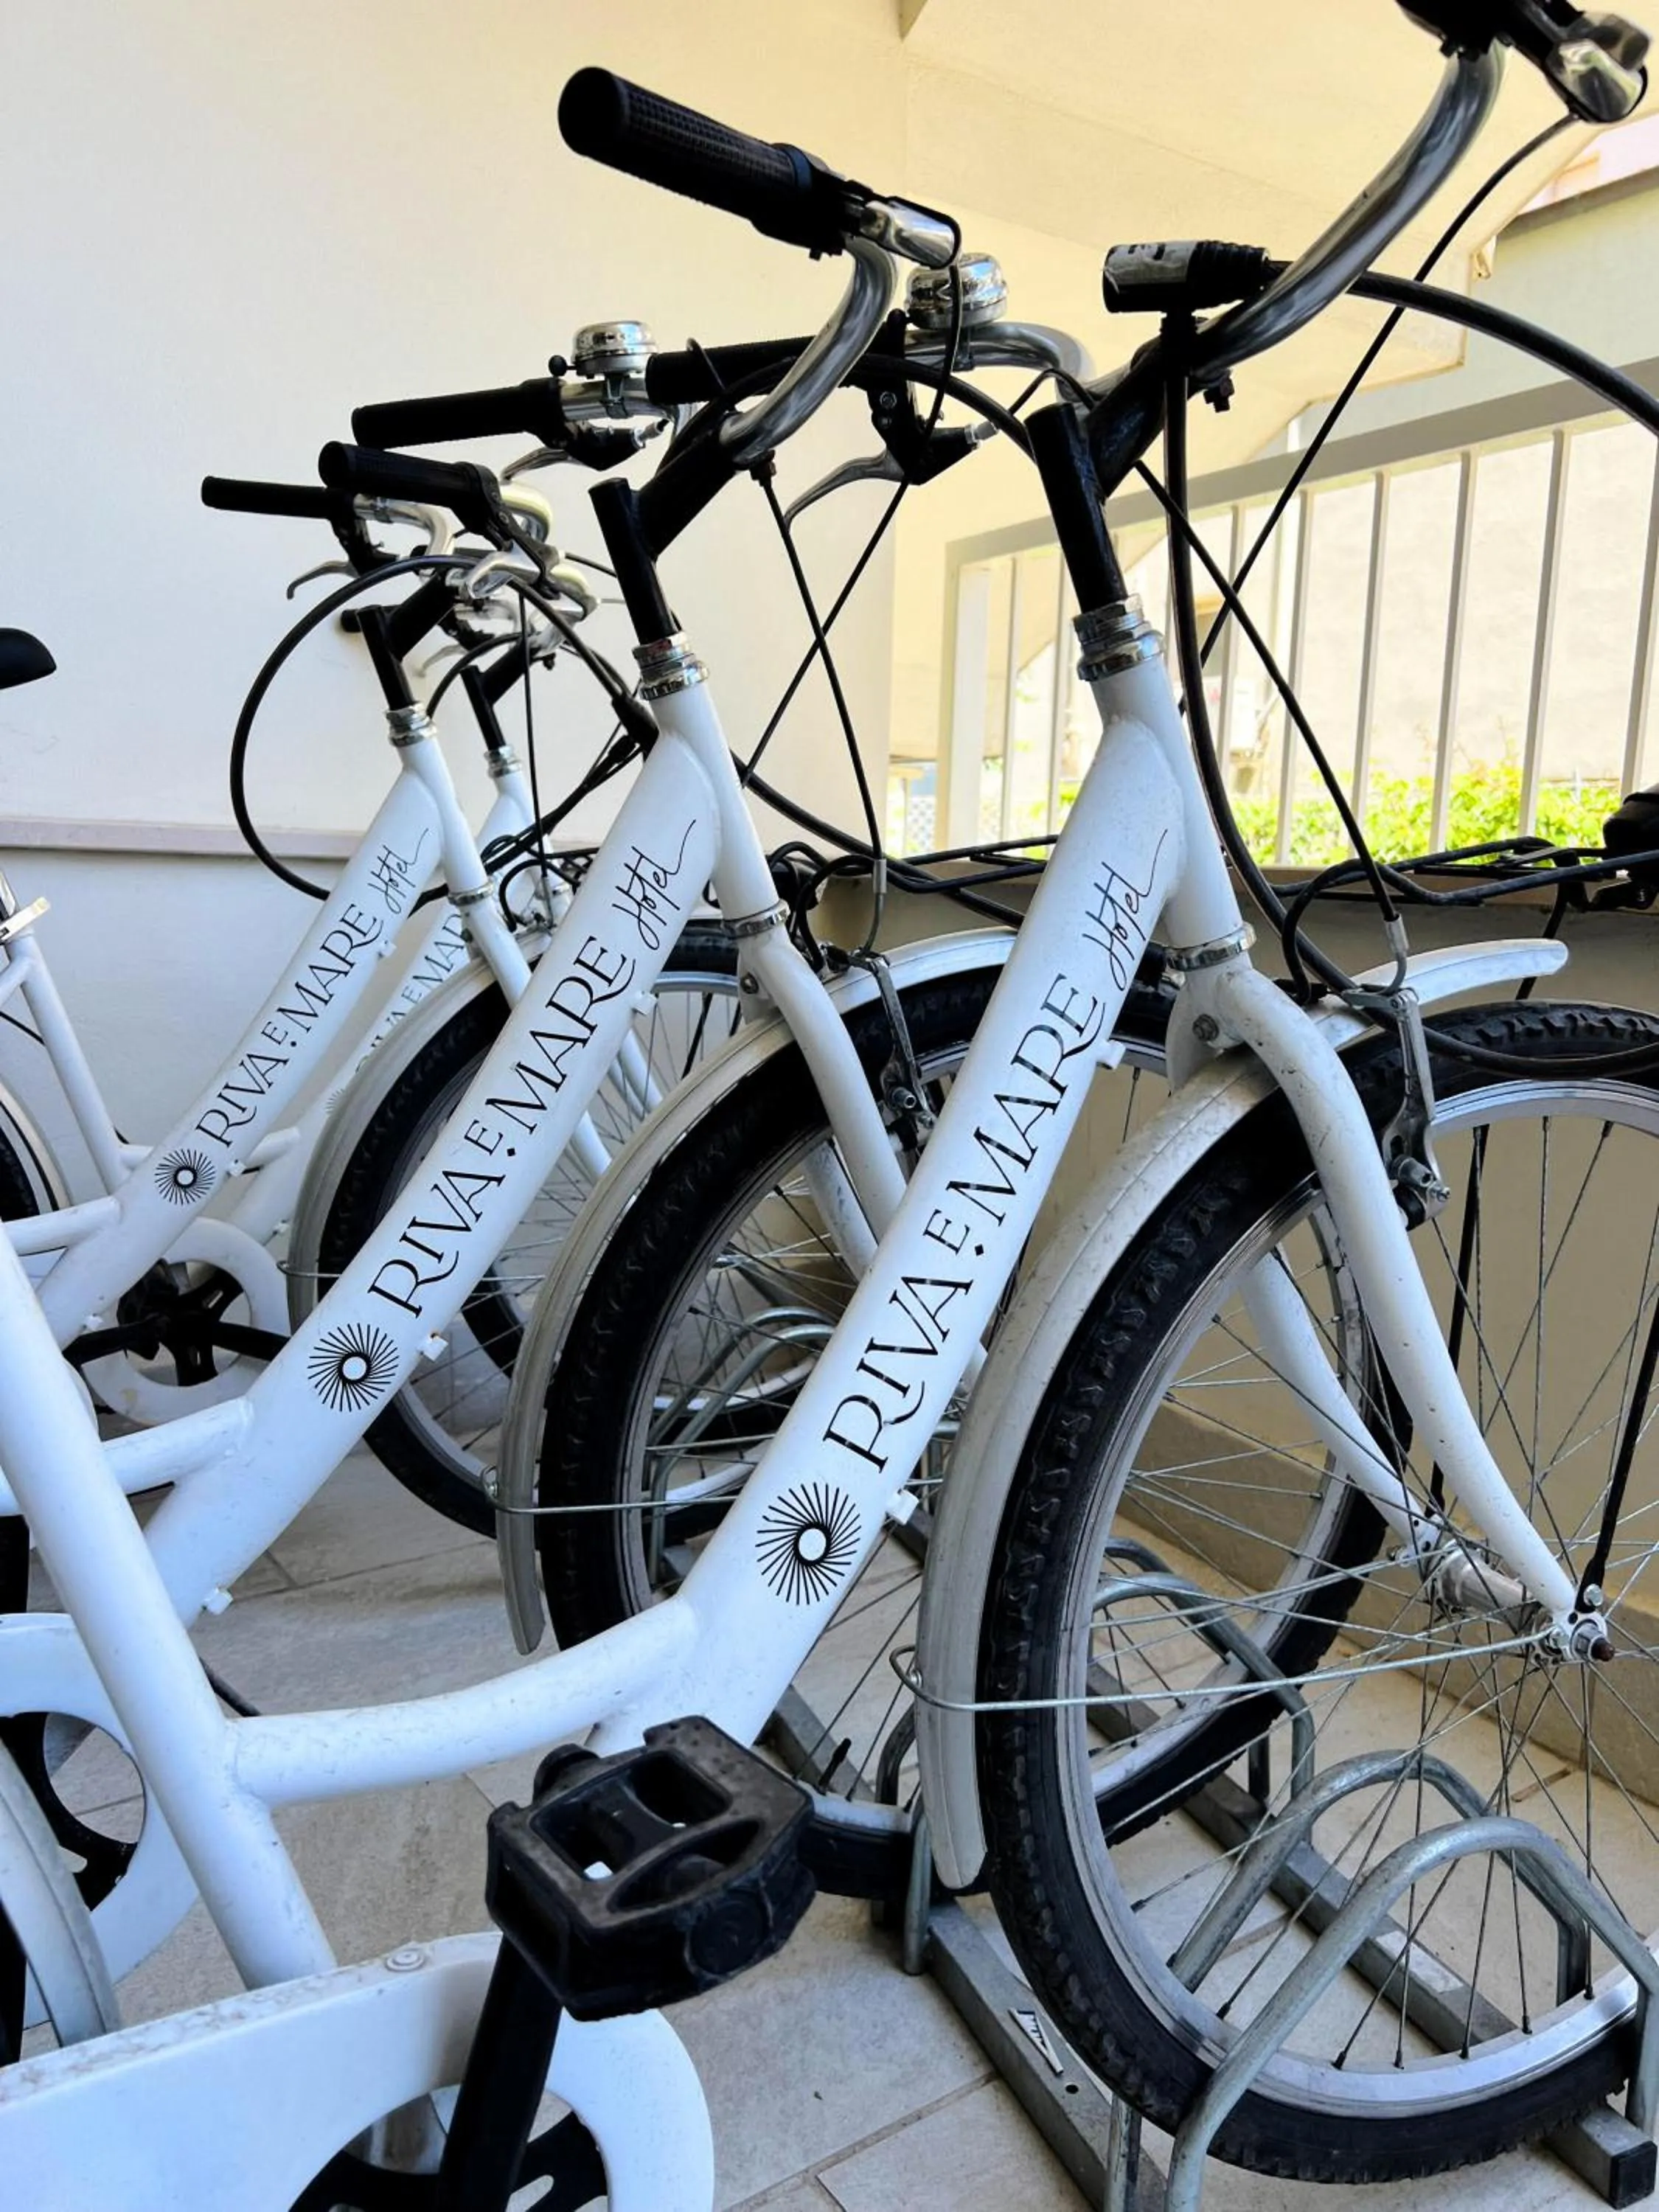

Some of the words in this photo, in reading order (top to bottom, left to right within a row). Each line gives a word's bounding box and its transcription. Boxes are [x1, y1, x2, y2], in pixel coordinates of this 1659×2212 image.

[194, 1053, 291, 1149] RIVA
[275, 902, 384, 1034] MARE
[366, 827, 429, 915] Hotel
[367, 1169, 507, 1320] RIVA
[484, 935, 636, 1135] MARE
[611, 818, 697, 951] Hotel
[822, 1275, 974, 1475] RIVA
[945, 973, 1107, 1228] MARE
[1081, 828, 1169, 992] Hotel
